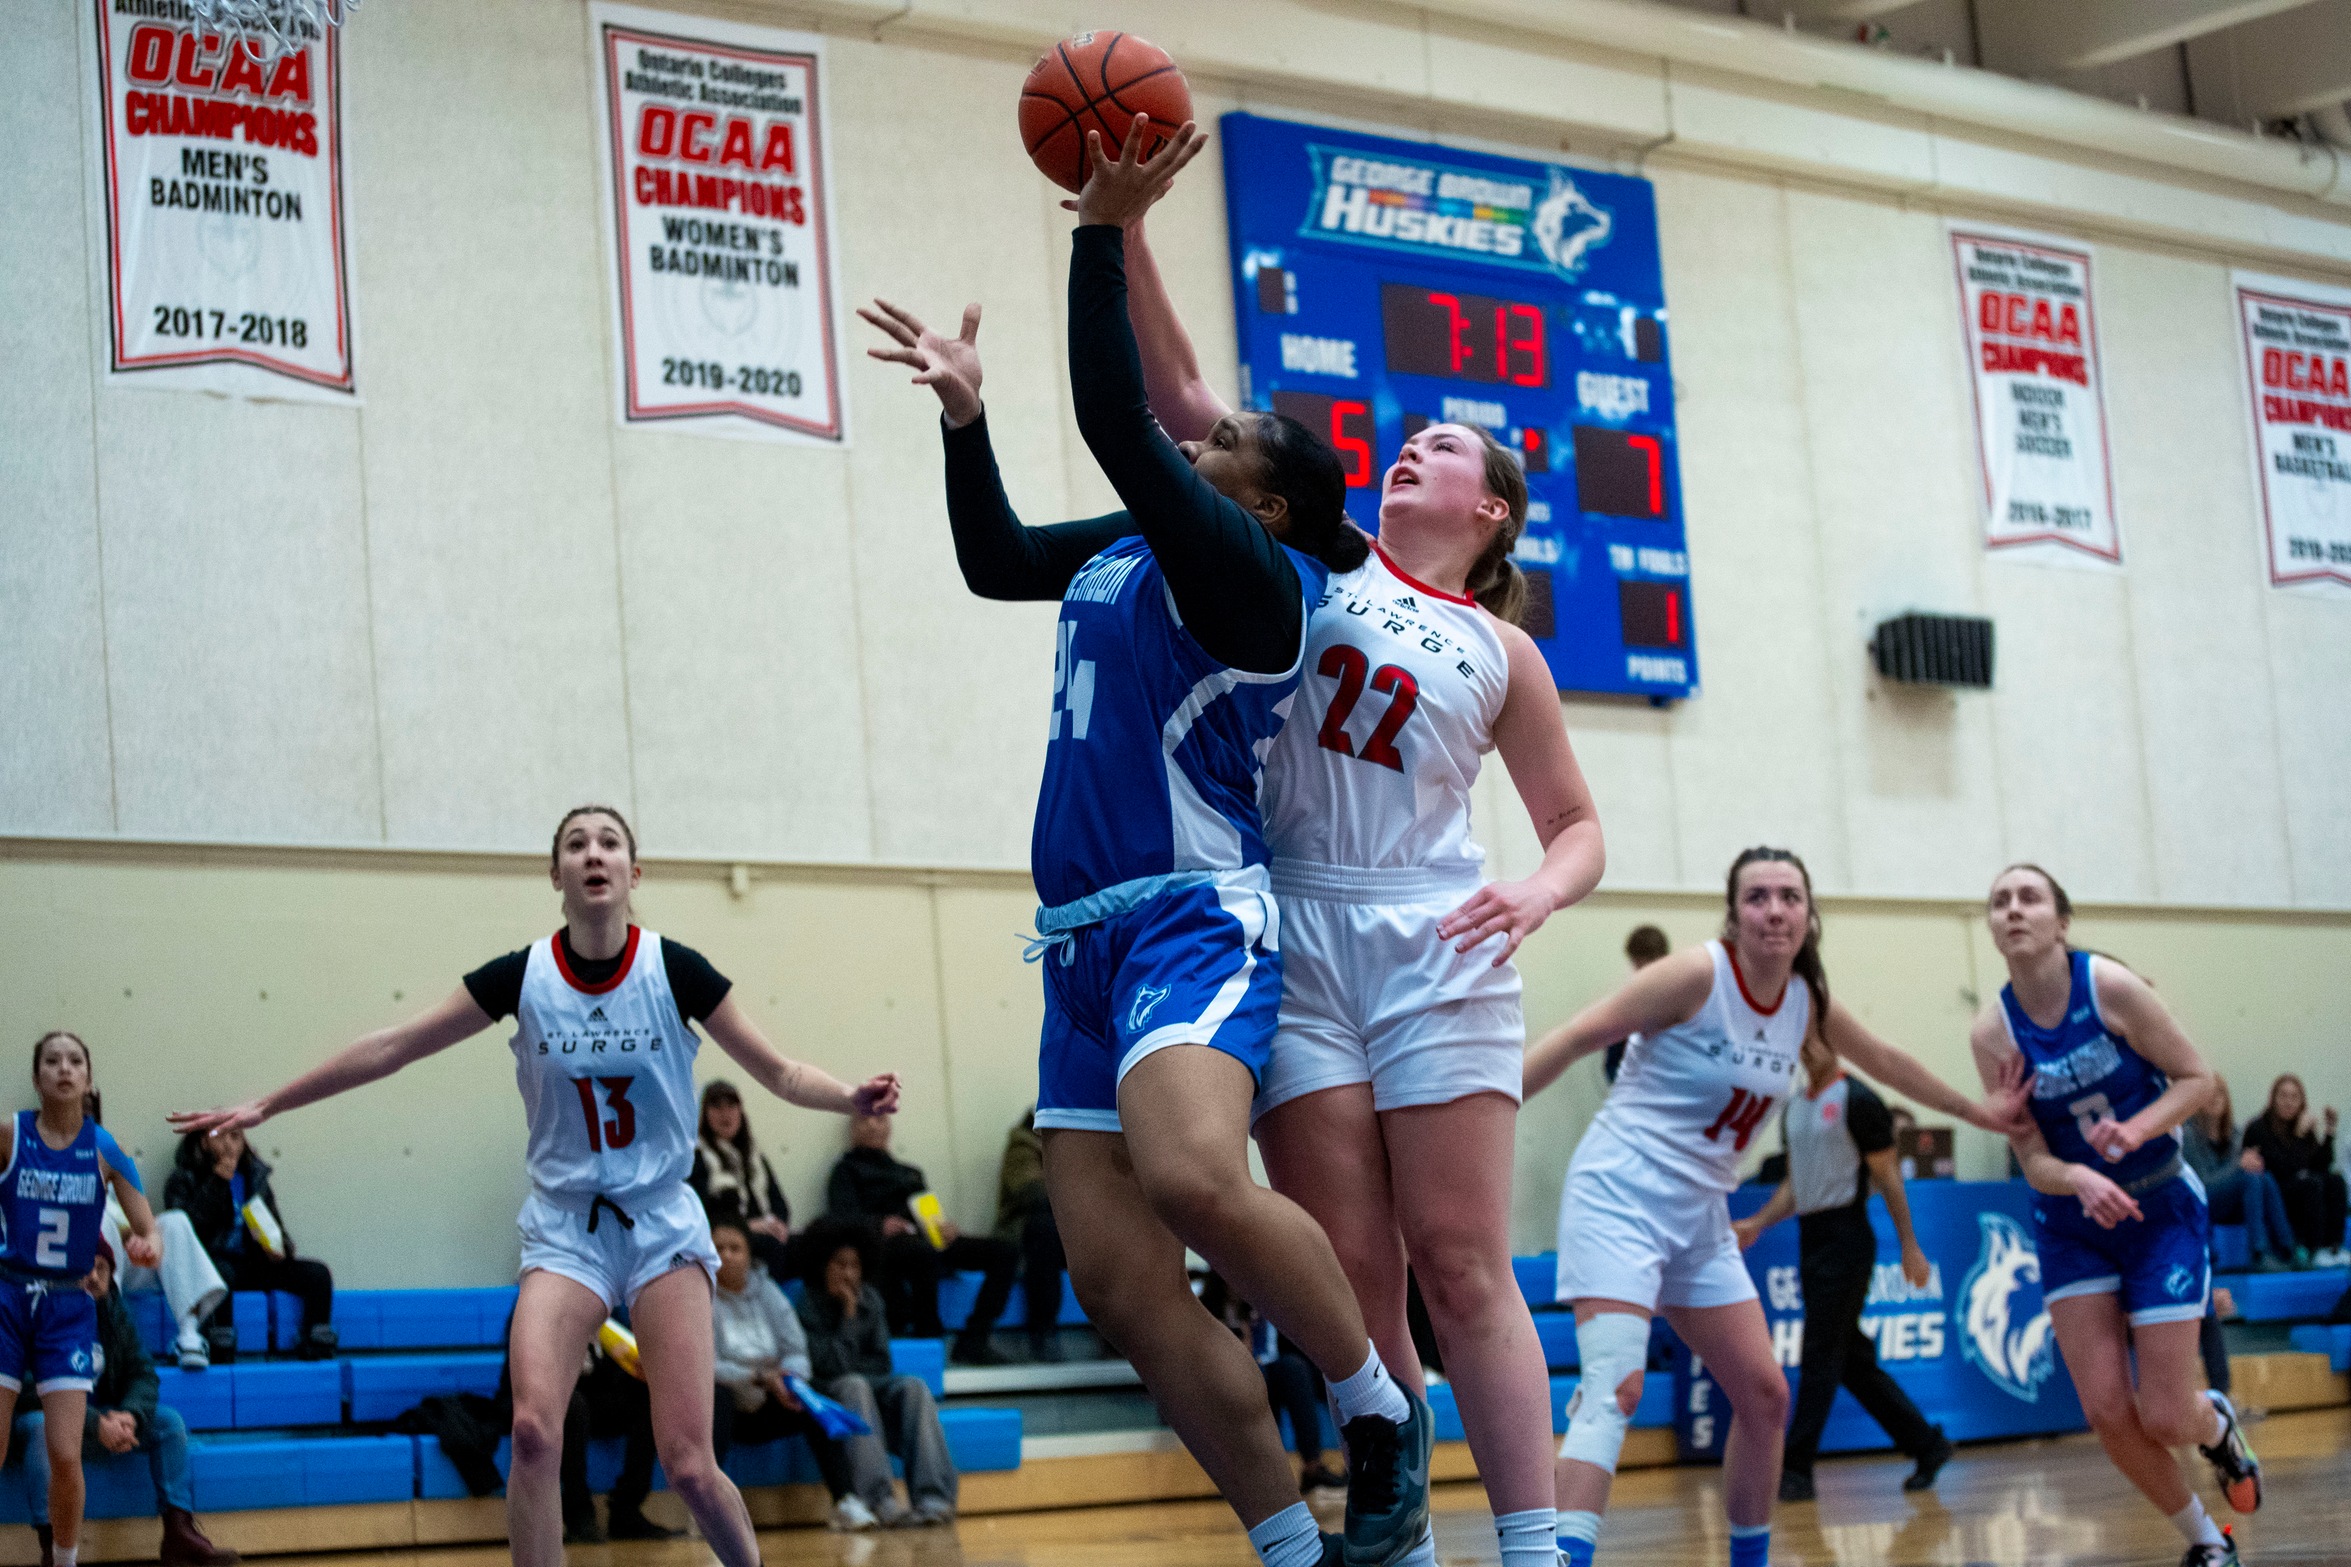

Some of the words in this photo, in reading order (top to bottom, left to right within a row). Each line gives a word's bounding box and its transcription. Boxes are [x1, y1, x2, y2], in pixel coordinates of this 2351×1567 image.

[127, 23, 312, 105] OCAA
[126, 91, 318, 157] CHAMPIONS
[637, 106, 796, 174] OCAA
[182, 148, 268, 185] MEN'S
[151, 177, 302, 221] BADMINTON
[635, 165, 806, 226] CHAMPIONS
[1321, 184, 1525, 256] HUSKIES
[662, 215, 783, 255] WOMEN'S
[650, 245, 799, 287] BADMINTON
[154, 306, 307, 348] 2017-2018
[1429, 293, 1544, 388] 7:13
[1979, 290, 2081, 348] OCAA
[662, 358, 802, 398] 2019-2020
[1281, 333, 1358, 379] HOME
[1981, 340, 2088, 388] CHAMPIONS
[2263, 346, 2349, 398] OCAA
[1331, 401, 1371, 487] 5
[1628, 434, 1662, 515] 7
[1366, 598, 1466, 654] LAWRENCE
[1667, 591, 1678, 643] 1
[1317, 644, 1420, 774] 22
[538, 1037, 662, 1055] SURGE
[572, 1028, 651, 1038] LAWRENCE
[568, 1074, 636, 1153] 13
[1704, 1086, 1774, 1152] 14
[17, 1168, 60, 1201] GEORGE
[36, 1207, 70, 1268] 2
